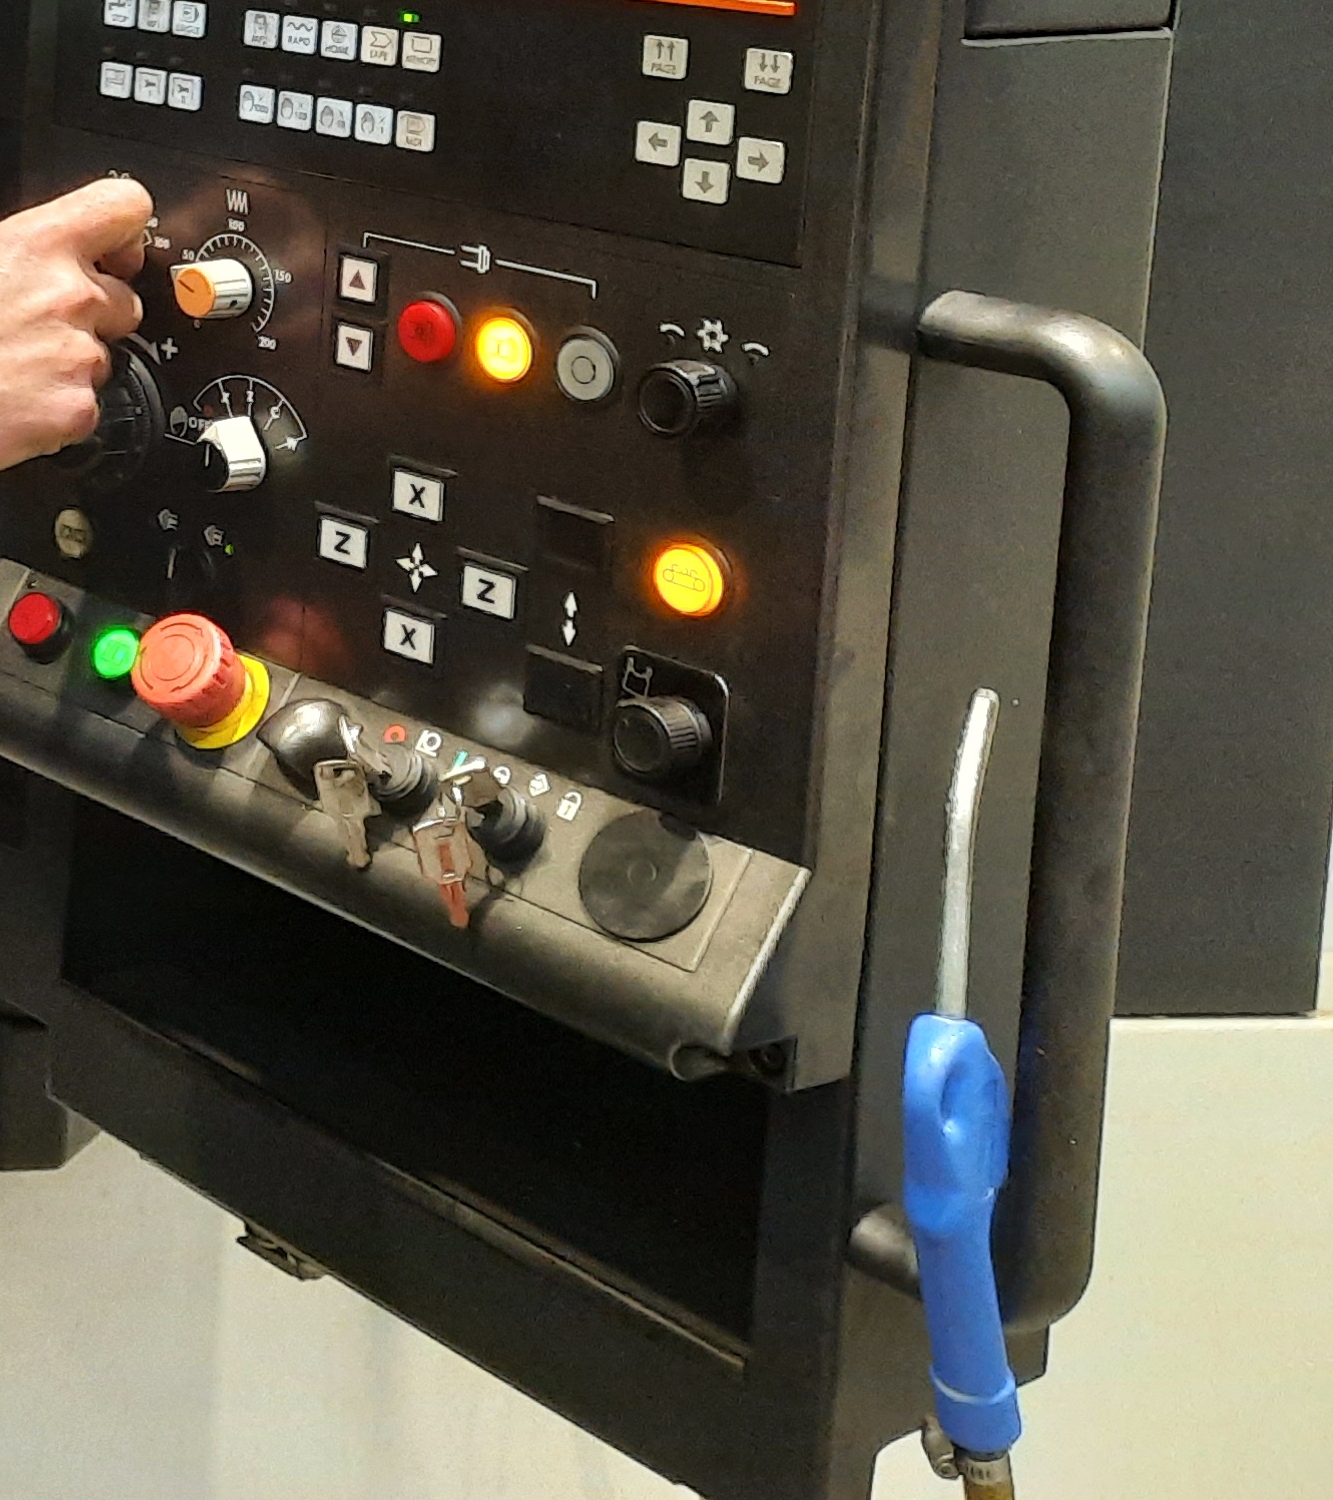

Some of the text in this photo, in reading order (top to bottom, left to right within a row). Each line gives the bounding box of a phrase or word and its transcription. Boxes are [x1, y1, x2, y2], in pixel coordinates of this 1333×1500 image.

[182, 248, 196, 262] 50
[273, 268, 293, 285] 150
[257, 335, 278, 351] 200
[409, 483, 426, 509] X
[334, 530, 351, 555] Z
[477, 578, 496, 604] Z
[400, 623, 417, 650] X
